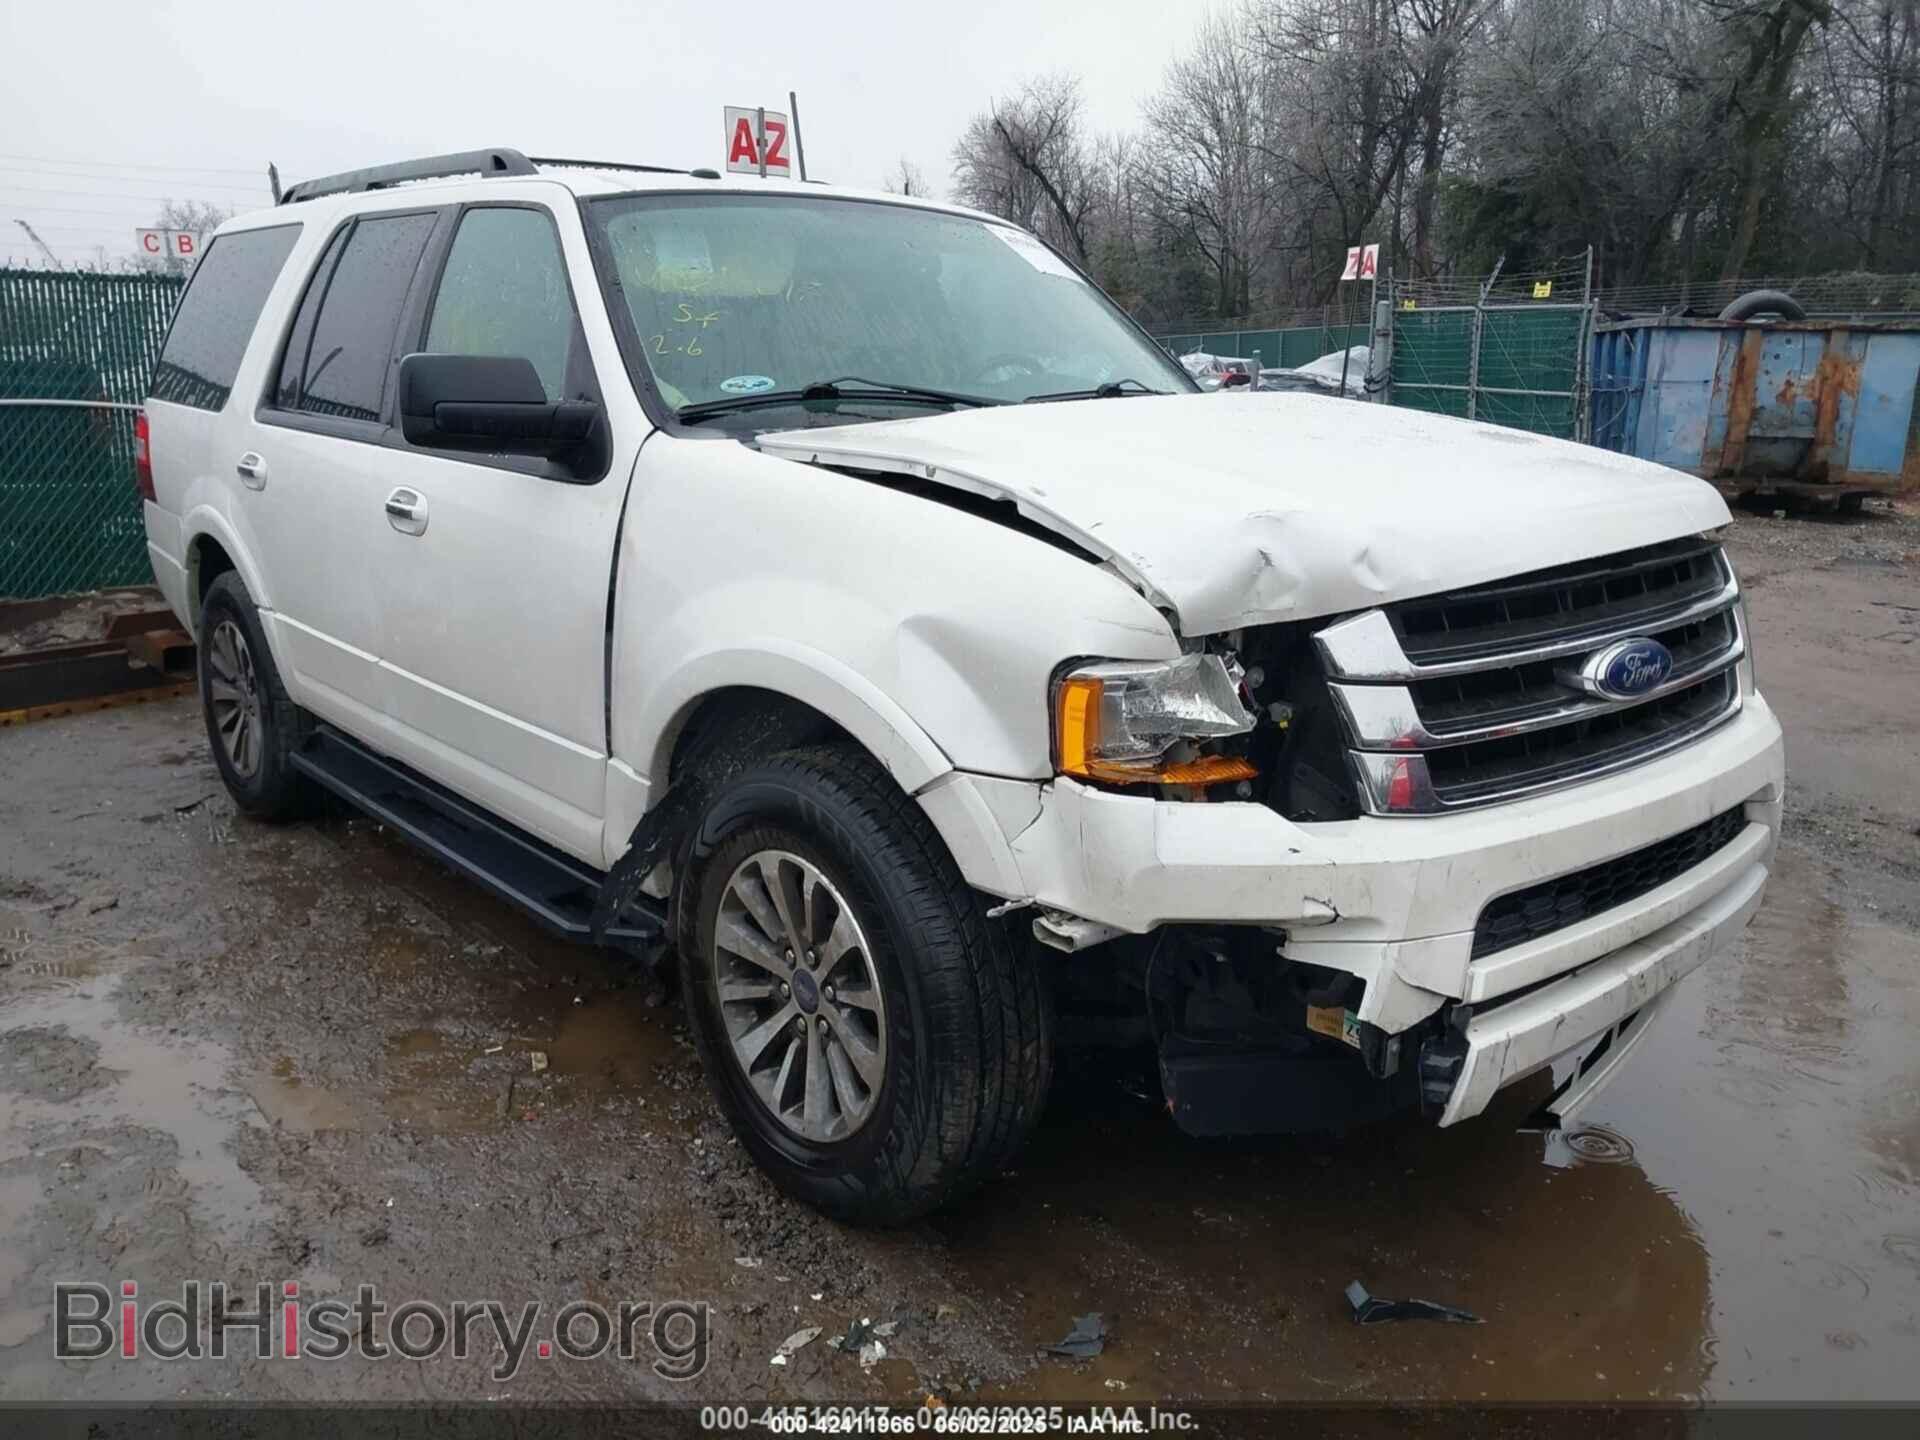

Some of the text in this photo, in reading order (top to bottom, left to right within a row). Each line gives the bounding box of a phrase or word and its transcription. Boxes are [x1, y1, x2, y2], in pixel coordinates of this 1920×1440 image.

[144, 234, 194, 253] C B
[1622, 651, 1663, 688] Ford
